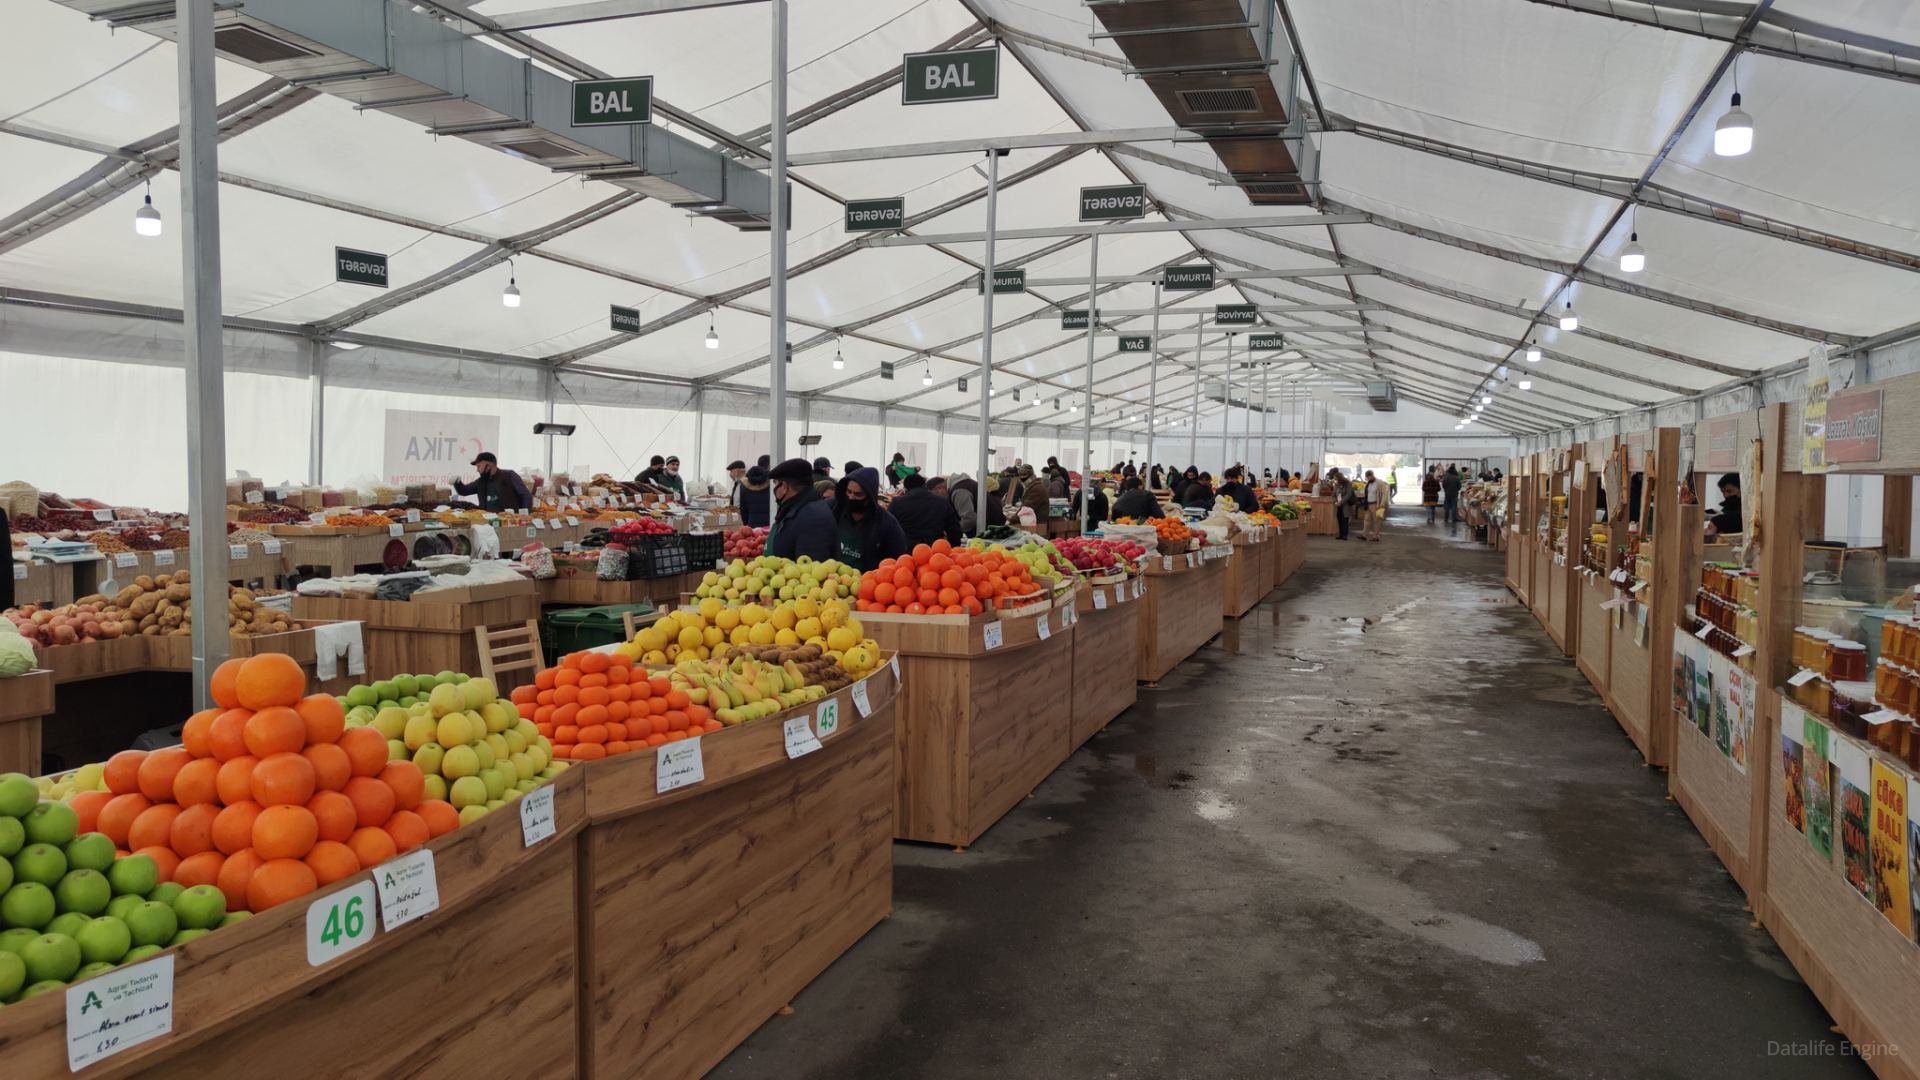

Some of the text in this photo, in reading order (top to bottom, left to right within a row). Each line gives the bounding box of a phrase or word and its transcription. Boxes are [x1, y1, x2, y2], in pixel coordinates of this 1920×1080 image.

[924, 62, 976, 90] BAL
[590, 90, 633, 114] BAL
[1083, 195, 1142, 210] TƏRƏVƏZ
[848, 208, 901, 222] TƏRƏVƏZ
[340, 259, 386, 276] TƏRƏVƏZ
[1167, 273, 1211, 282] YUMURTA
[1217, 310, 1255, 319] ƏDVİYYAT
[1125, 338, 1145, 350] YAĞ
[1250, 338, 1282, 347] PENDİR
[821, 705, 835, 730] 45
[1877, 807, 1902, 846] BALI
[320, 895, 365, 947] 46
